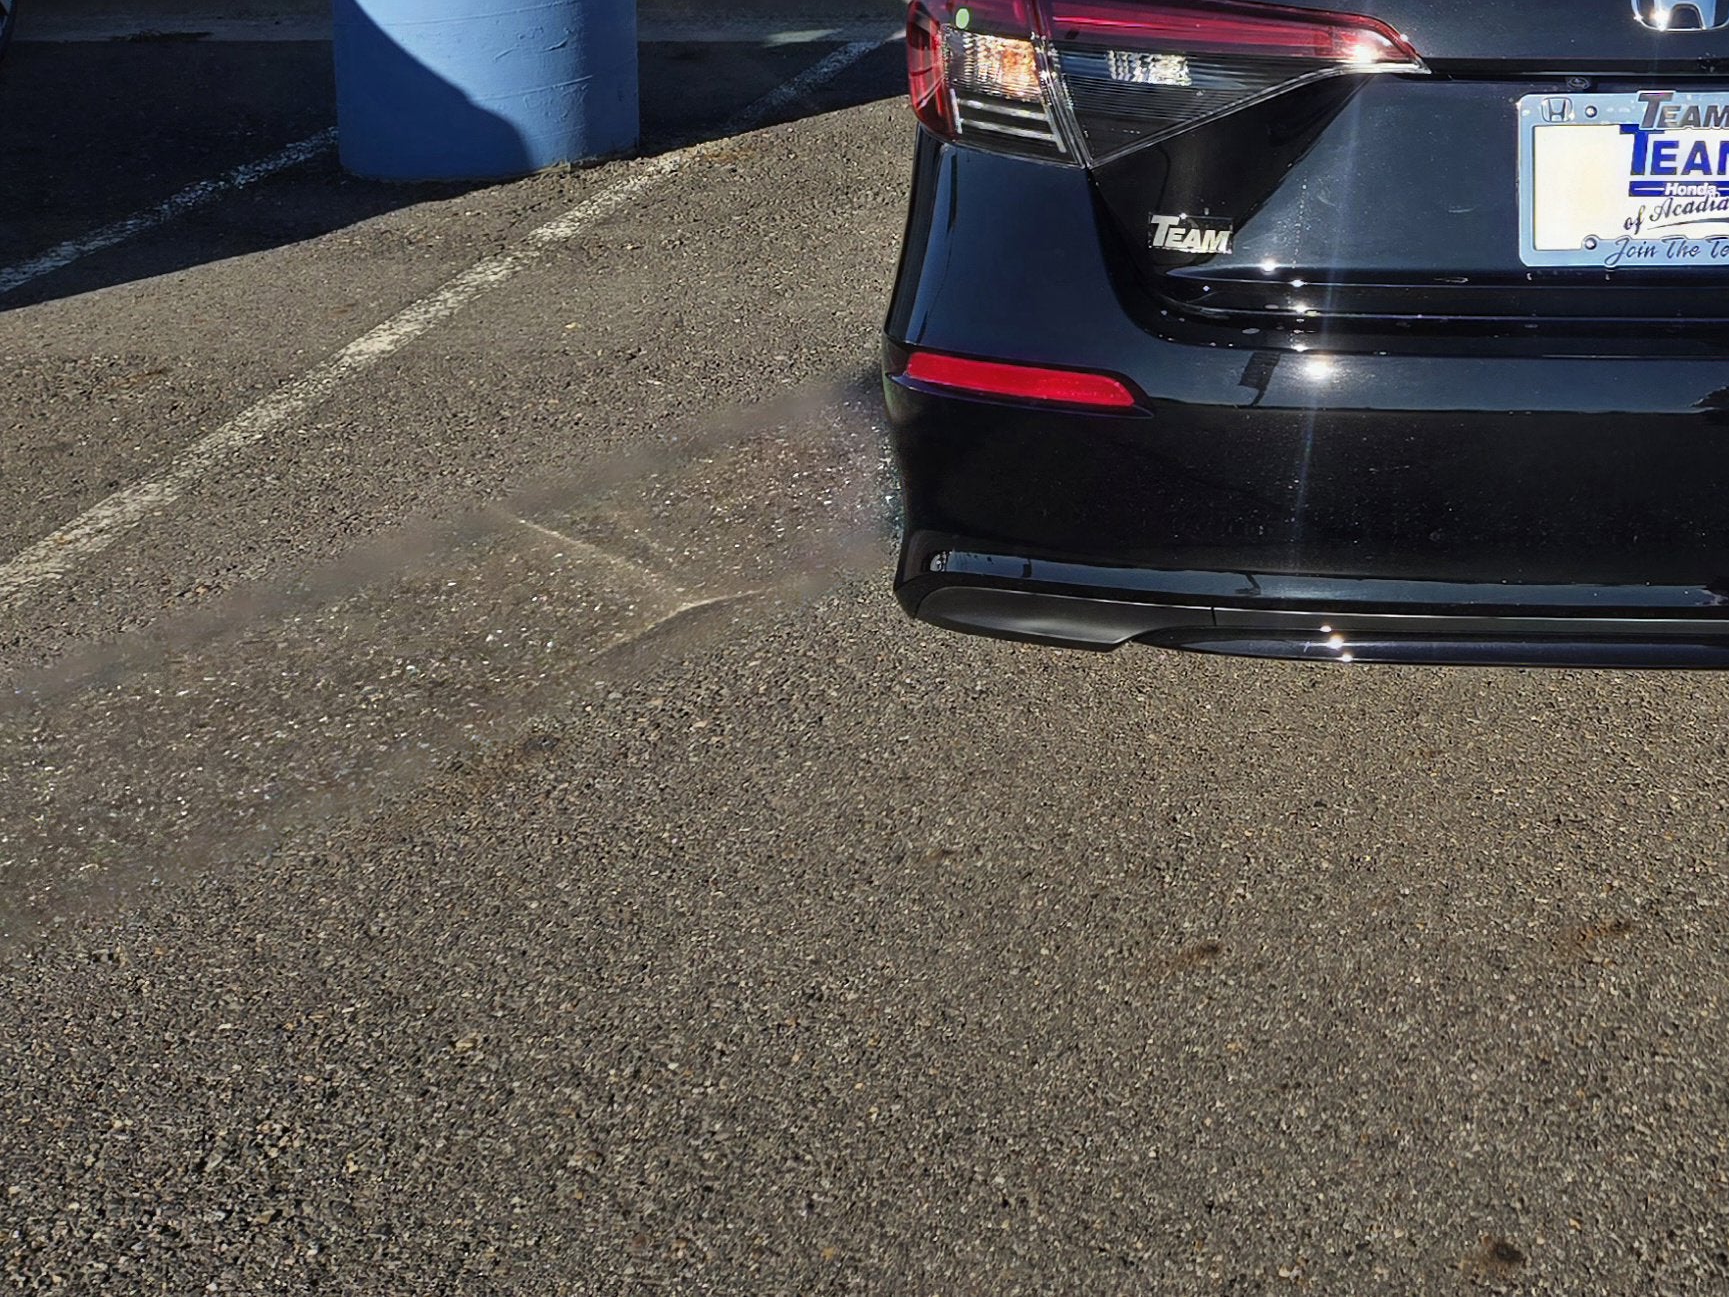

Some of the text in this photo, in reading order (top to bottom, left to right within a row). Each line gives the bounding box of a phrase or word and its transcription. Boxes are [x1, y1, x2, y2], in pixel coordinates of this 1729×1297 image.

[1664, 182, 1718, 197] Honda
[1151, 214, 1231, 253] TEAM
[1623, 205, 1646, 235] of
[1604, 236, 1656, 267] Join
[1661, 236, 1700, 259] The
